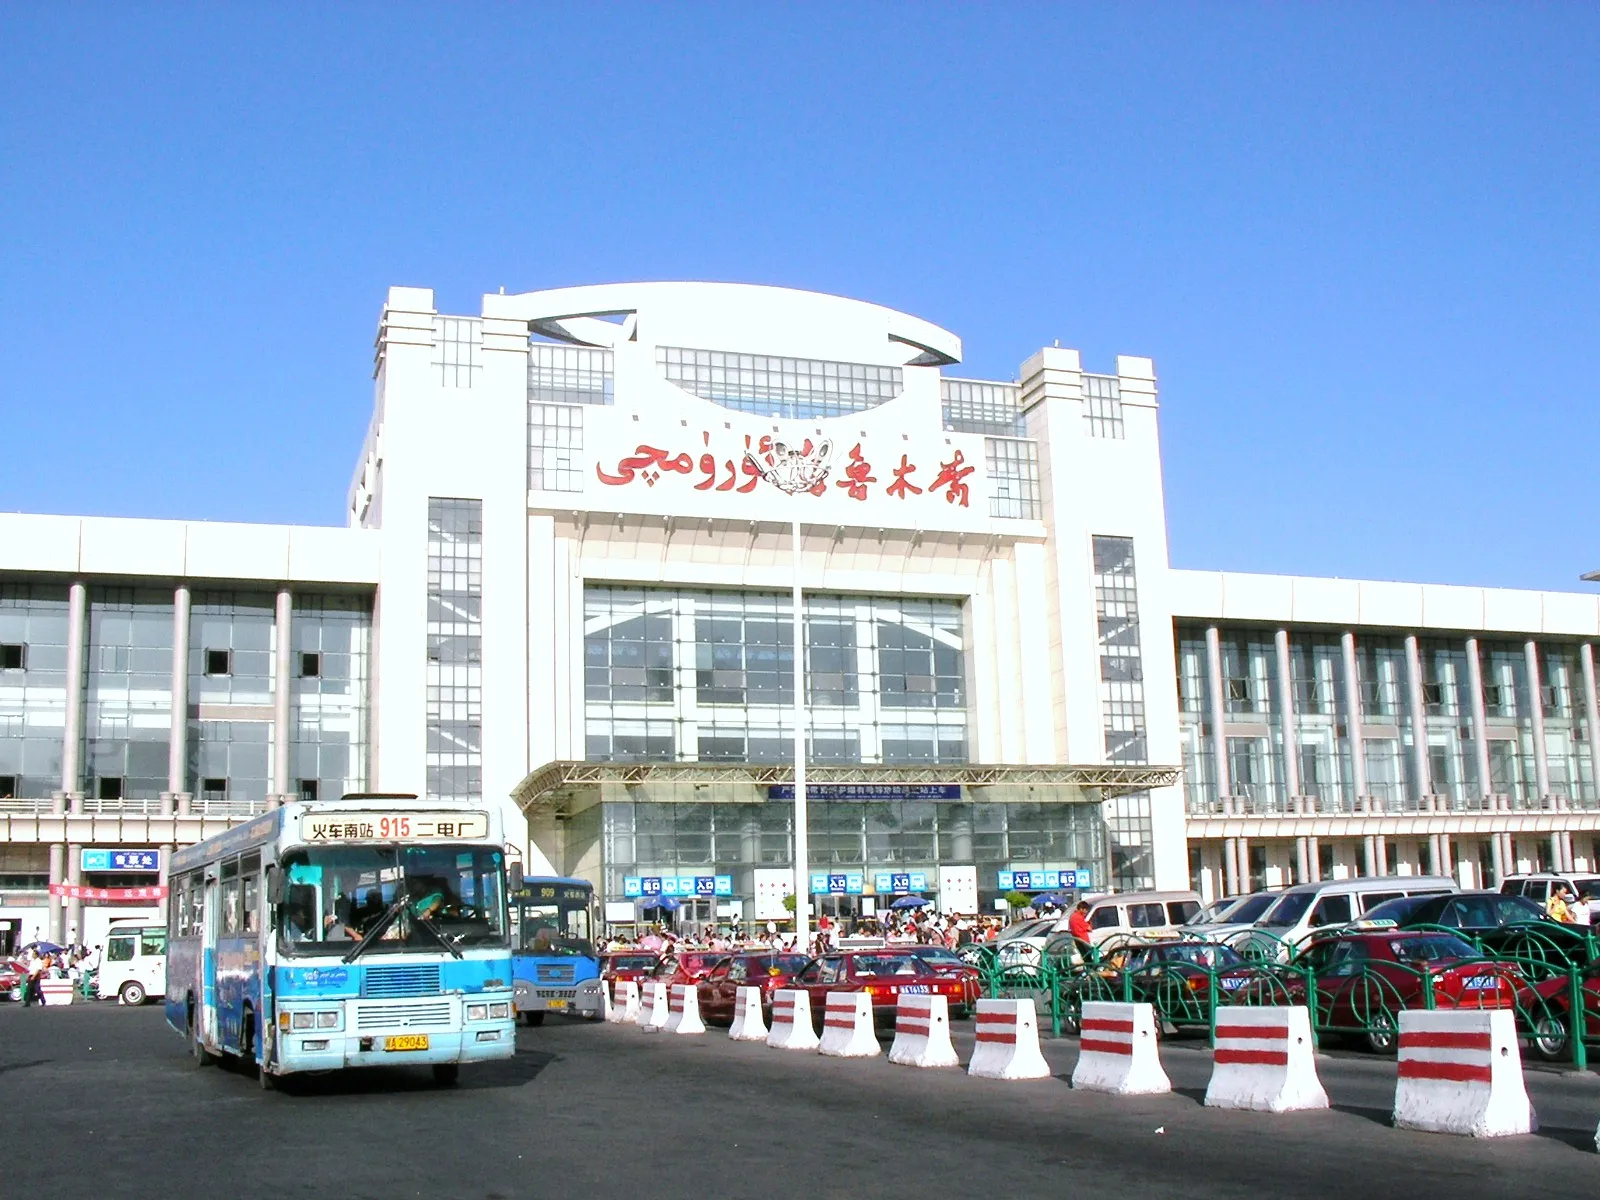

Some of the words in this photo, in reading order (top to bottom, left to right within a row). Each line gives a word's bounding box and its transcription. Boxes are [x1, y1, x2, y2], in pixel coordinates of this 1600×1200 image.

[312, 823, 373, 839] 火车南站
[380, 817, 411, 837] 915
[417, 822, 474, 837] 二电厂
[696, 880, 714, 890] 入口
[829, 879, 846, 888] 入口
[893, 878, 910, 887] 入口
[1015, 876, 1030, 885] 入口
[541, 888, 555, 898] 909
